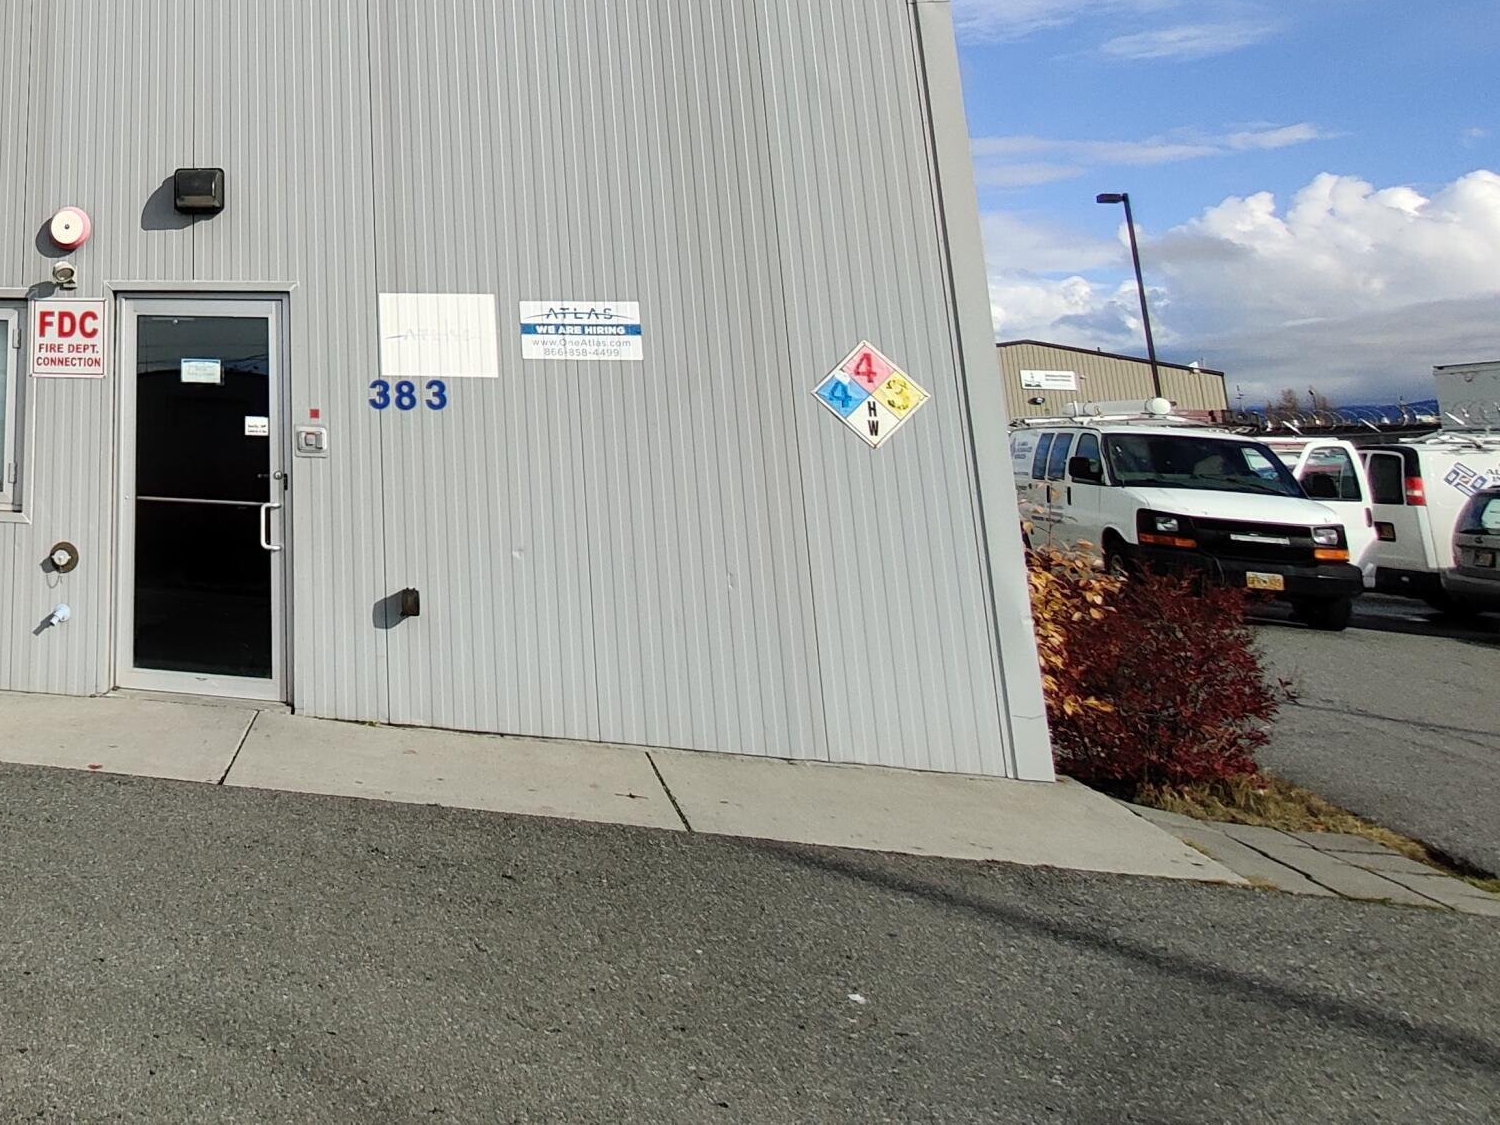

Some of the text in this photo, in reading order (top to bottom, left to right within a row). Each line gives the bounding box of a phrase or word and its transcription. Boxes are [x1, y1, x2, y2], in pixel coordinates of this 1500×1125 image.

[546, 307, 614, 320] ATLAS
[39, 311, 99, 339] FDC
[535, 325, 626, 335] WE ARE HIRING
[38, 343, 99, 353] FIRE DEPT.
[36, 356, 101, 367] CONNECTION
[854, 353, 877, 383] 4
[368, 379, 448, 411] 383
[829, 381, 852, 408] 4
[886, 379, 910, 410] 3
[867, 401, 878, 417] H
[868, 420, 879, 436] W
